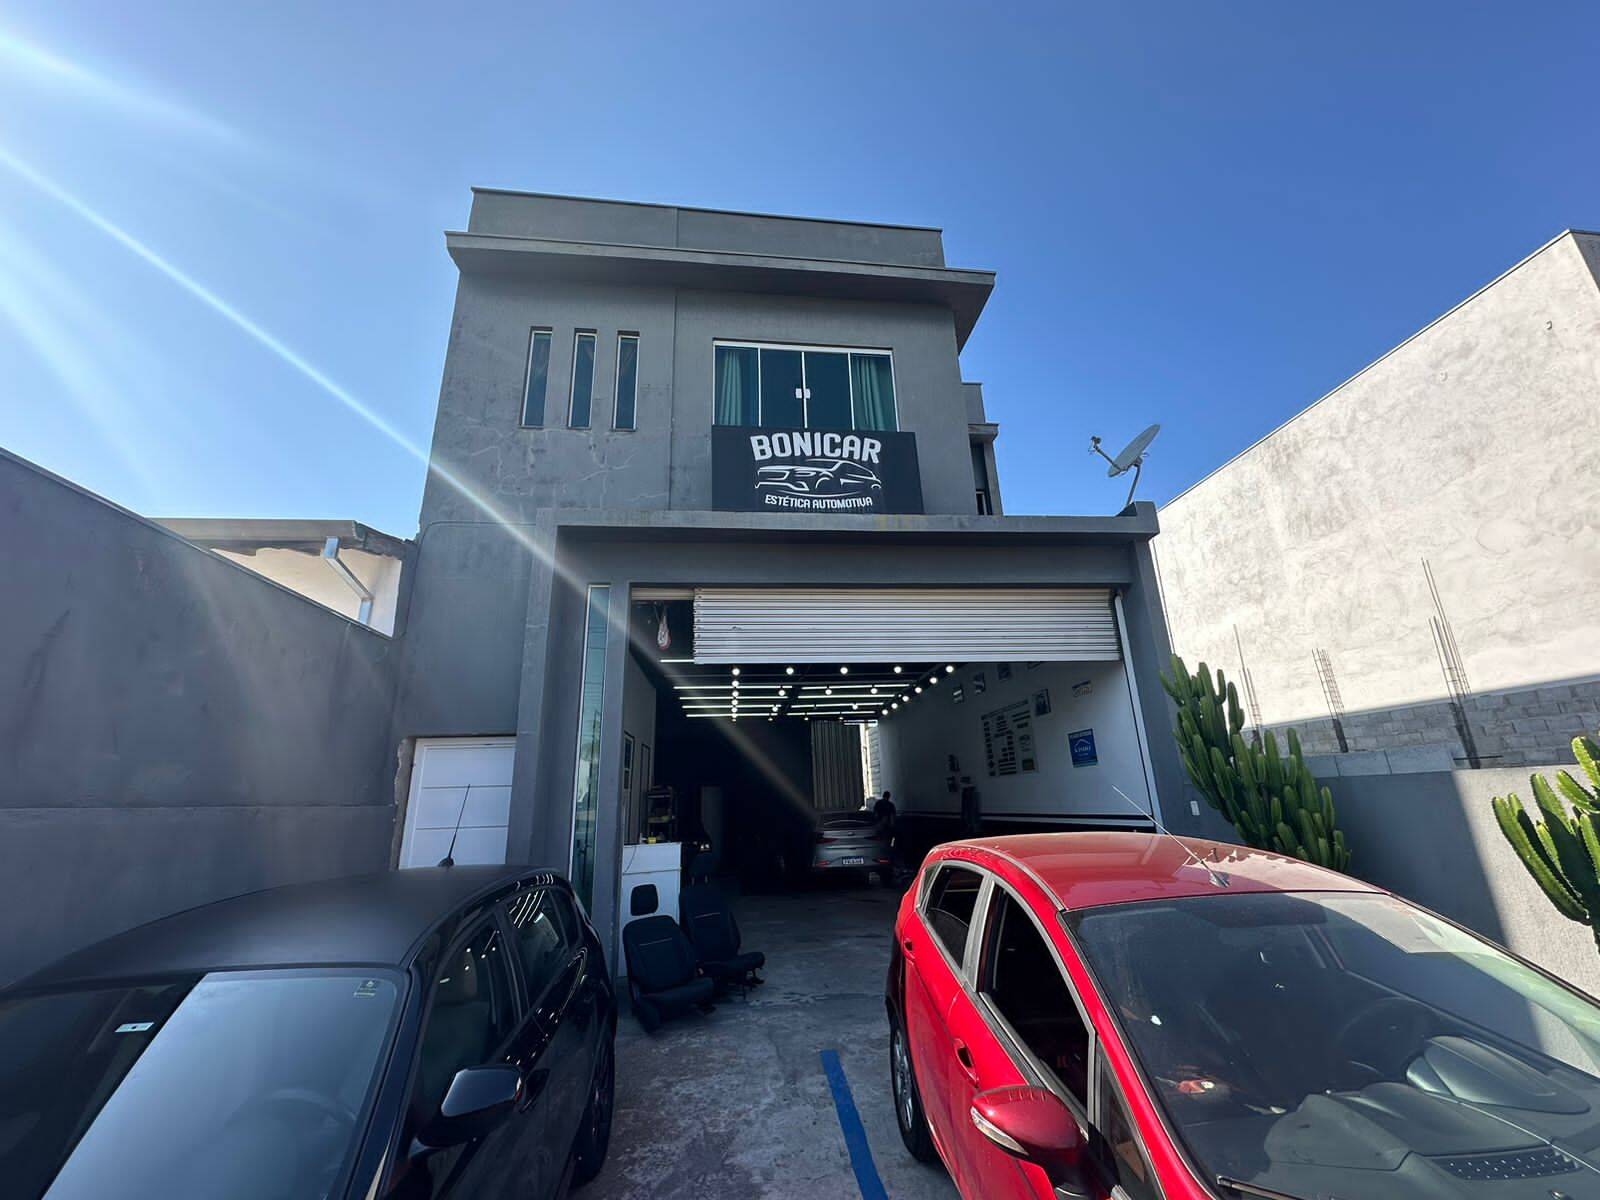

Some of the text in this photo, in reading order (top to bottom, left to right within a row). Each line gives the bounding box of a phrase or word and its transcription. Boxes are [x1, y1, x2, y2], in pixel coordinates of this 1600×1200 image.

[750, 432, 881, 464] BONICAR
[765, 494, 873, 509] ESTÉTICA AUTOMOTIVA
